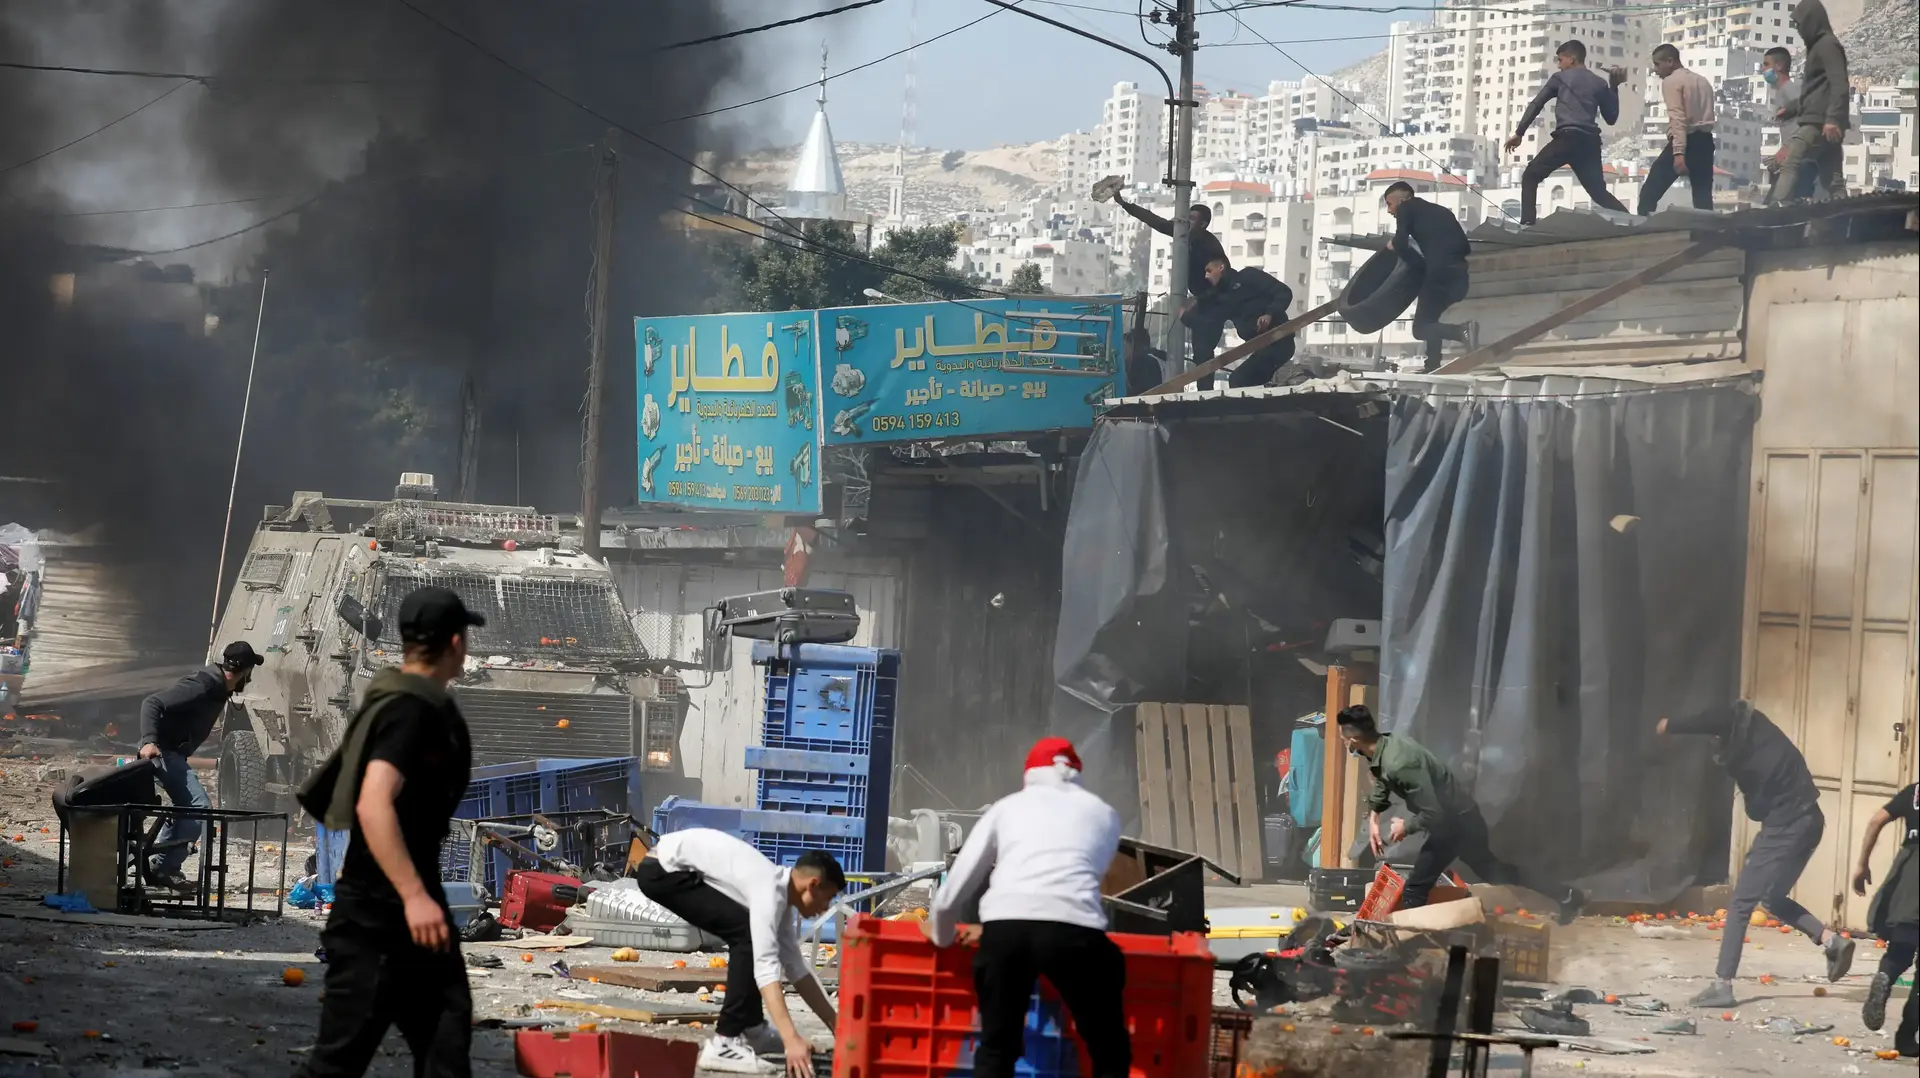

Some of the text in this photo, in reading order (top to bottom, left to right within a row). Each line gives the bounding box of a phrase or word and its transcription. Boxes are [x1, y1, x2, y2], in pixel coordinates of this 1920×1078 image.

[890, 308, 1058, 371] فطاير
[667, 321, 779, 413] فطاير
[935, 358, 975, 374] واليدوية
[904, 376, 943, 406] تأجير
[959, 379, 1005, 401] صيانة
[1021, 380, 1048, 399] بيع
[696, 398, 723, 423] واليدوية
[757, 399, 779, 418] للعدد
[872, 411, 960, 432] 0594 159 413
[674, 424, 702, 472] تأجير
[711, 434, 744, 475] صيانة
[755, 444, 774, 475] بيع
[667, 480, 683, 497] 0594
[683, 481, 695, 498] 159
